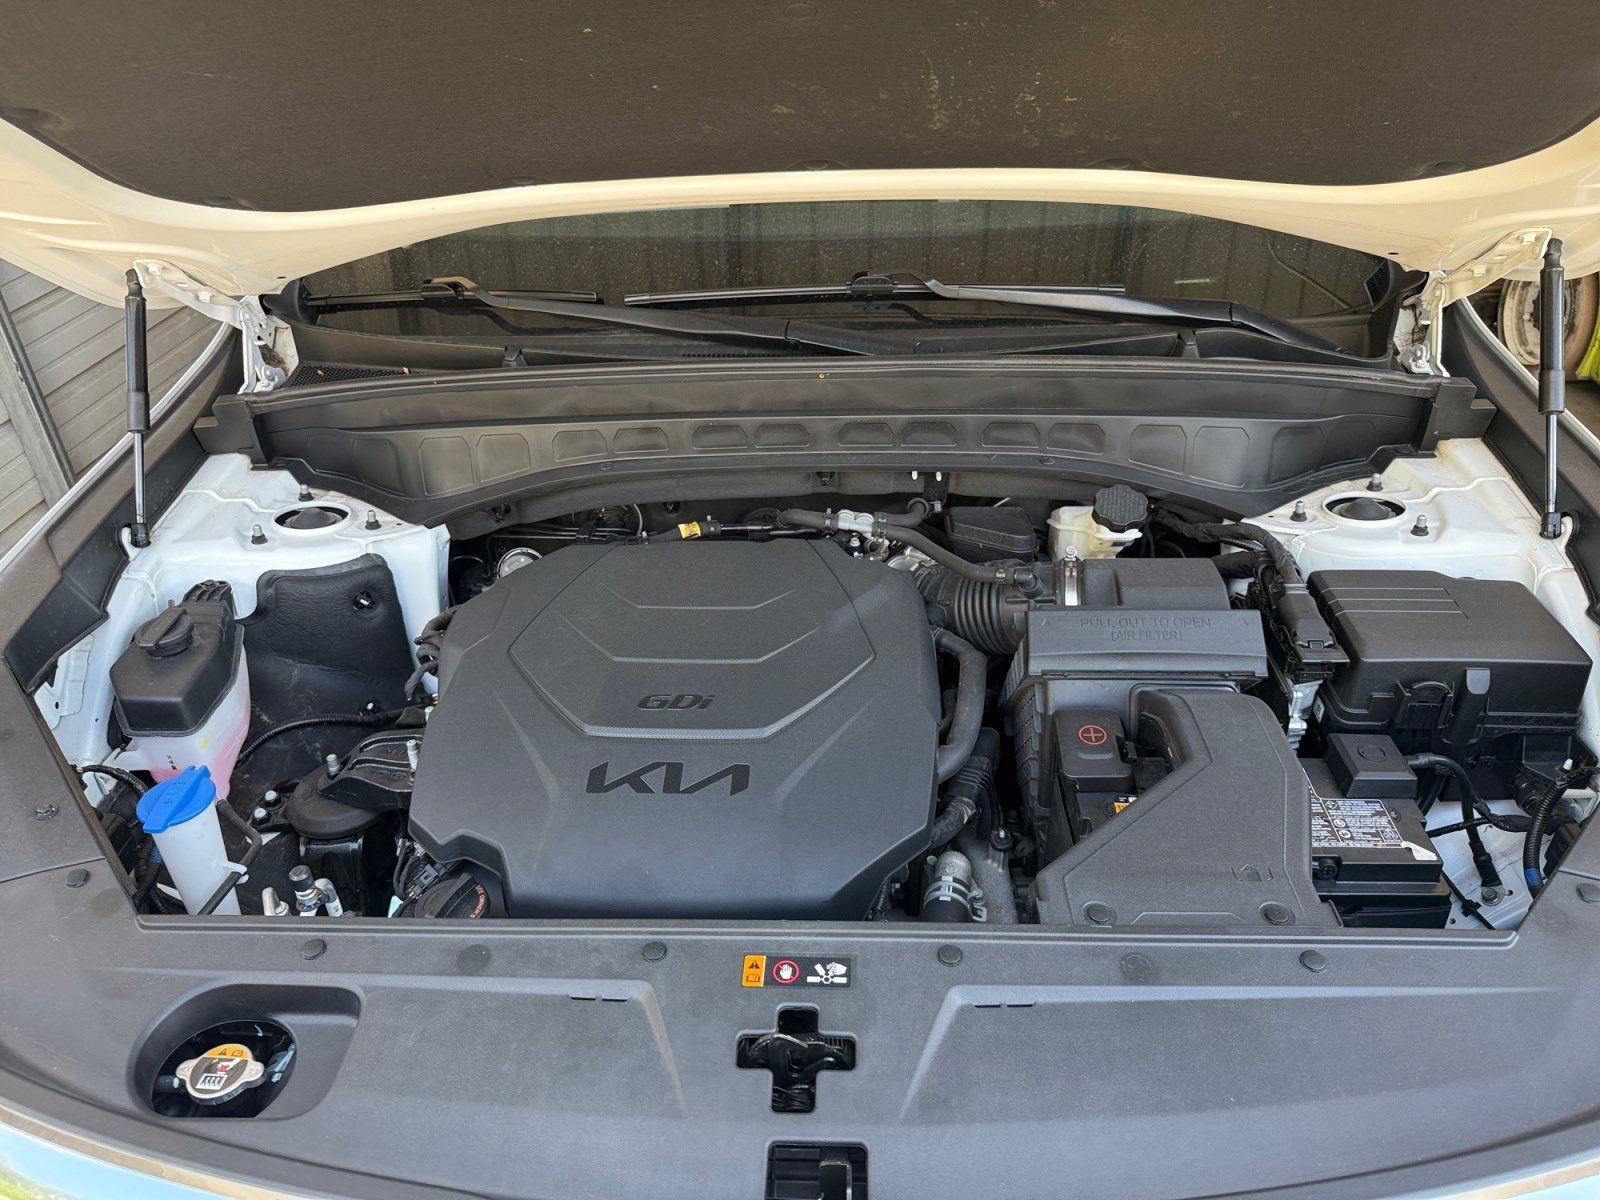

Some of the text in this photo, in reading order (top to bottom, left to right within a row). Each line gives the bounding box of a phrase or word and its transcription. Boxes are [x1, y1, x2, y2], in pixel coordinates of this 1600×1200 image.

[1080, 617, 1210, 628] PULL OUT TO OPEN
[637, 693, 716, 710] GDi
